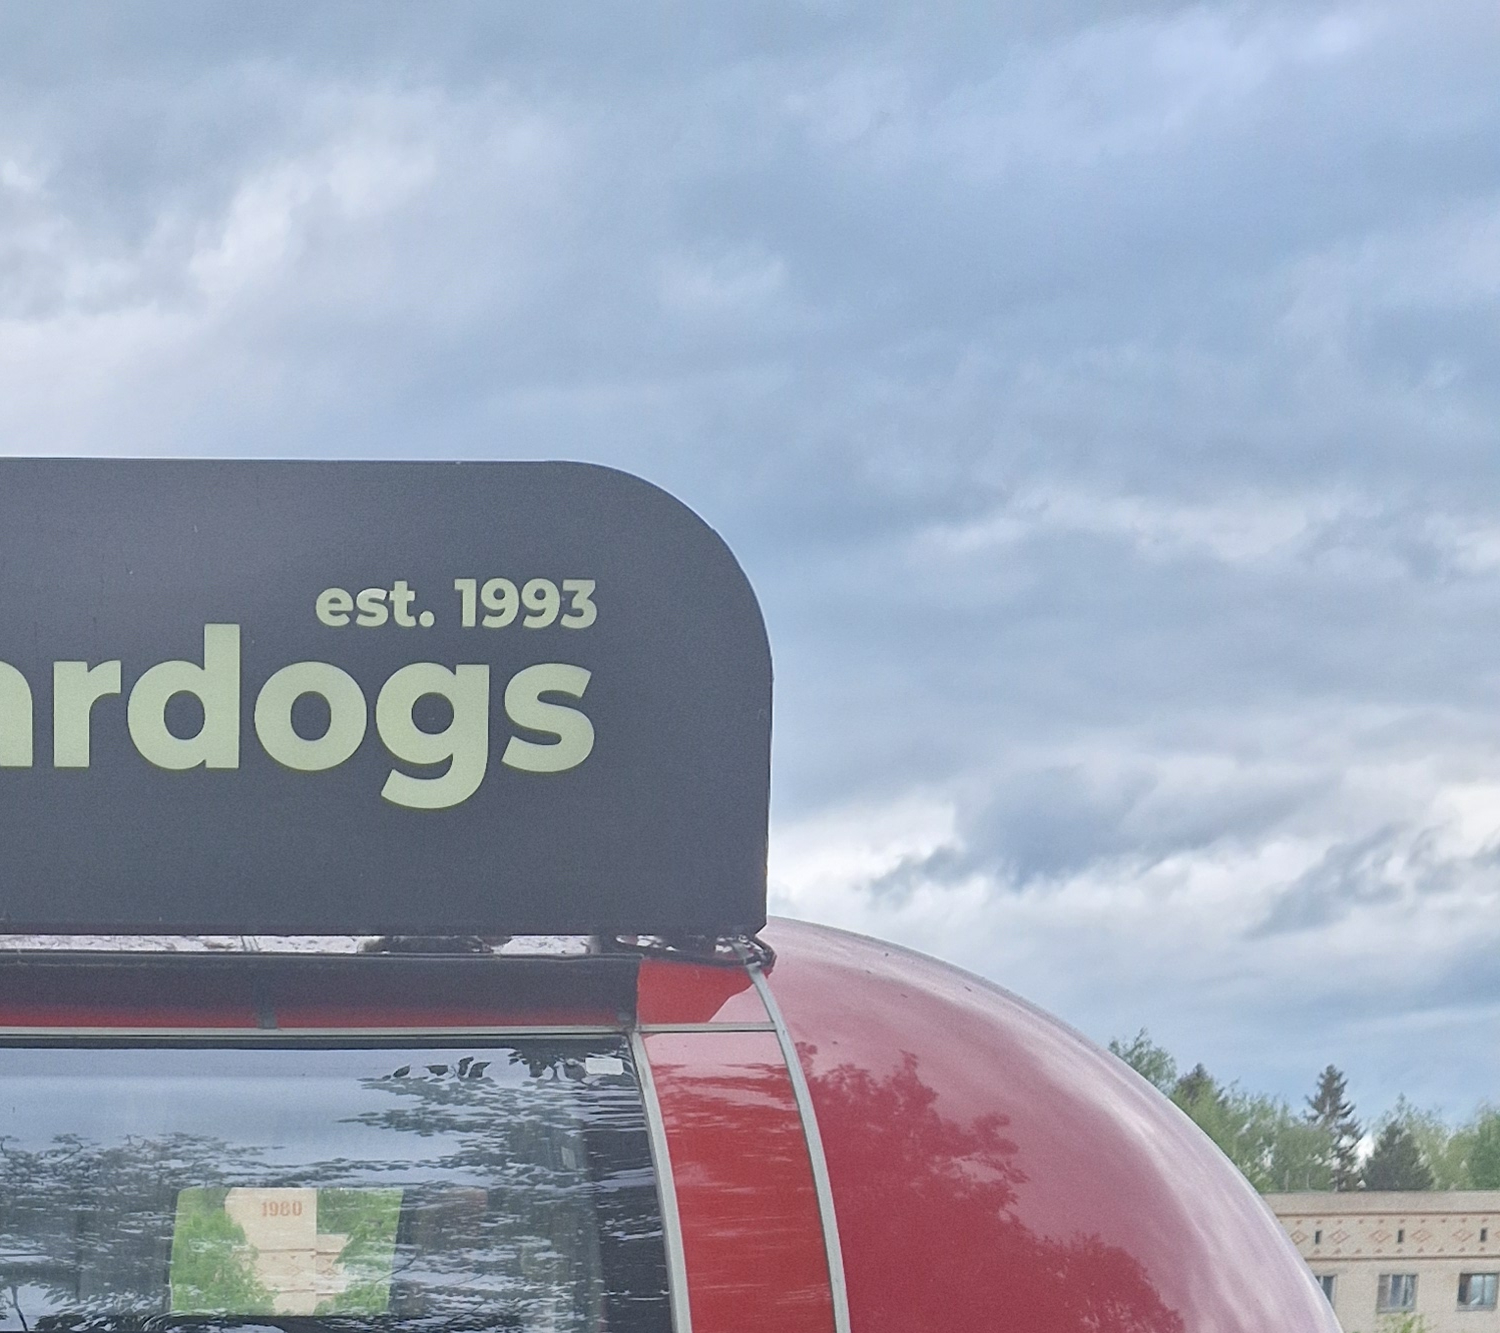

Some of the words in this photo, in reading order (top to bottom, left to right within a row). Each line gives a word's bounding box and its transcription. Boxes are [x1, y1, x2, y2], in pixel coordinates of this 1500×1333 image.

[315, 580, 435, 628] est.
[455, 579, 598, 630] 1993
[261, 1201, 302, 1217] 1980
